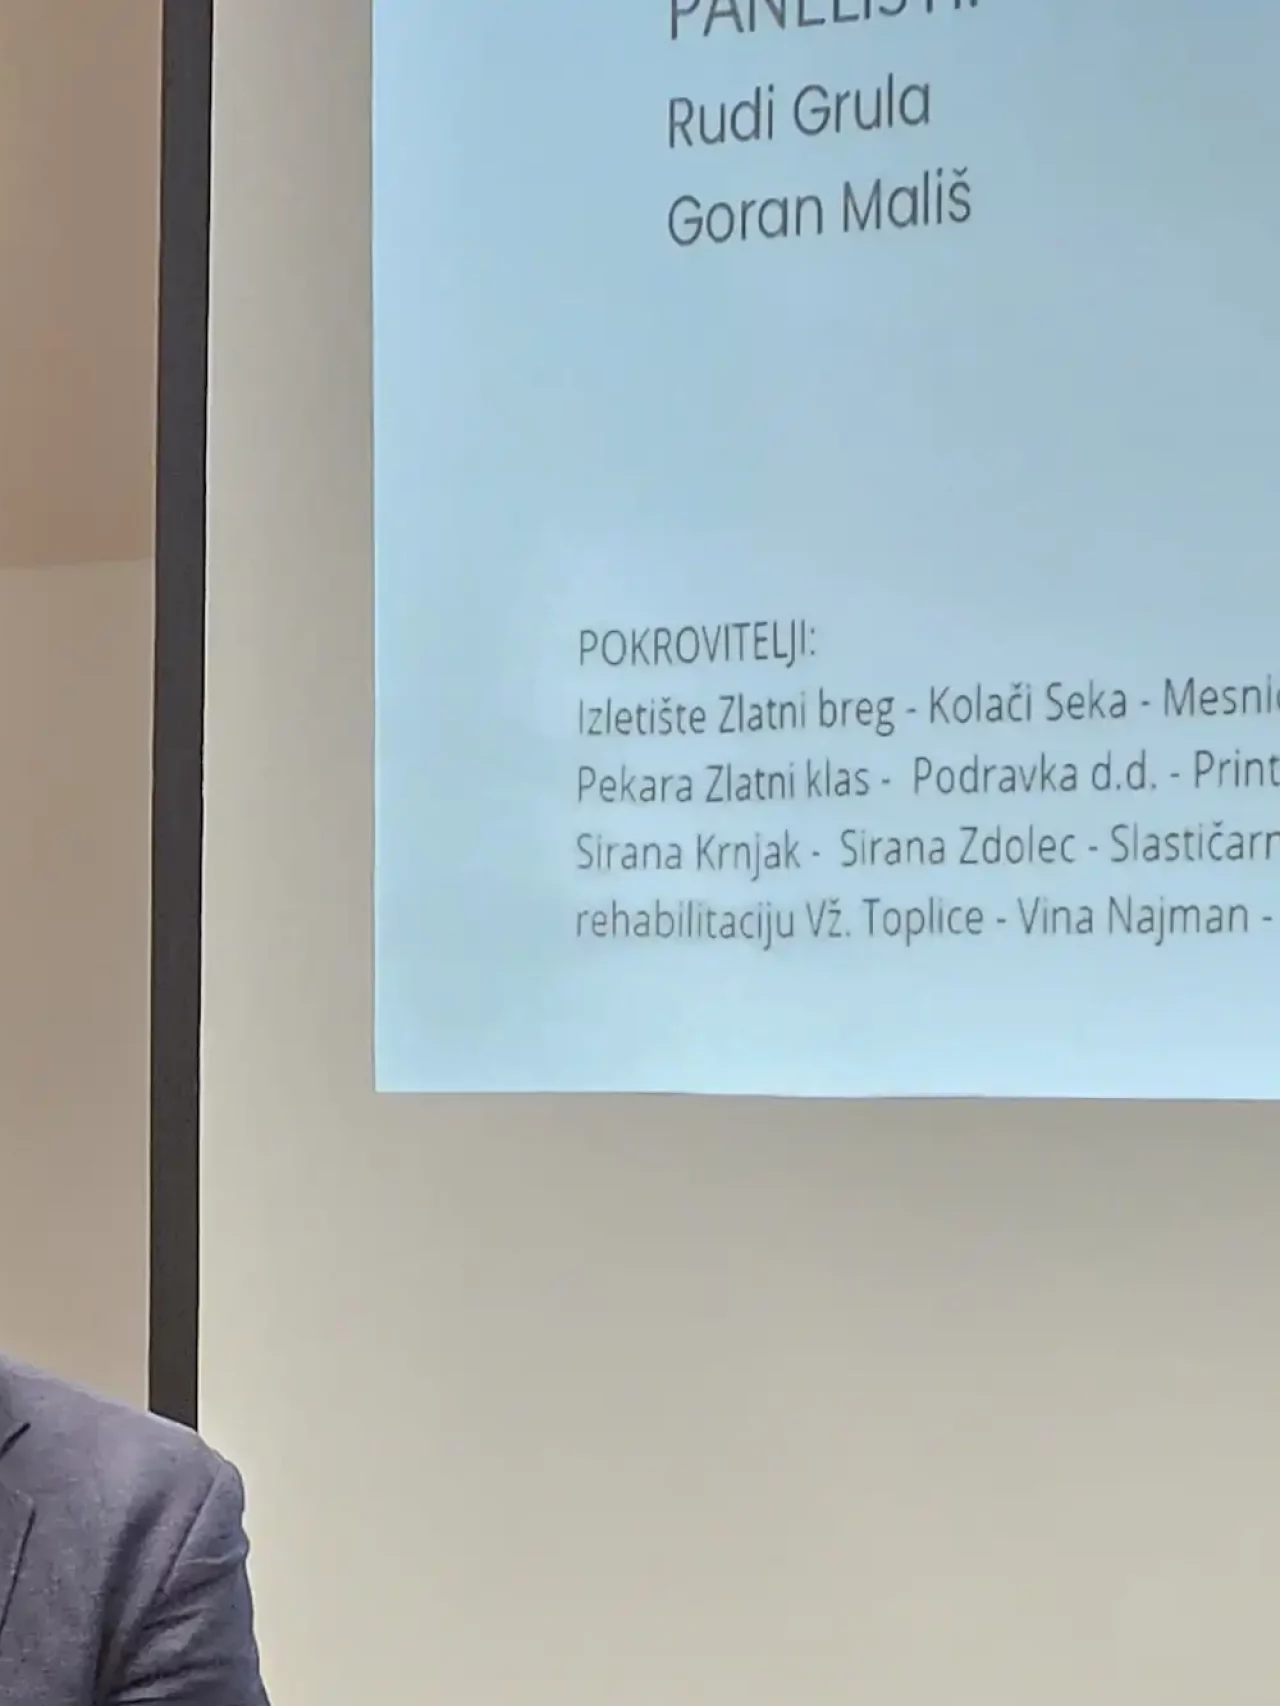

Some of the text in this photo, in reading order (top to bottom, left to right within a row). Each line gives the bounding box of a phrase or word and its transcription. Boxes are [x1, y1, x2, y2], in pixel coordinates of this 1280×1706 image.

[669, 72, 930, 149] Rudi Grula
[668, 166, 971, 247] Goran Mališ
[580, 619, 815, 669] POKROVITELJI:
[579, 697, 706, 736] Izletište
[719, 691, 805, 734] Zlatni
[819, 687, 895, 737] breg
[930, 682, 1031, 724] Kolači
[1046, 680, 1126, 721] Seka
[1164, 674, 1280, 717] Mesni
[578, 765, 692, 803] Pekara
[705, 763, 795, 803] Zlatni
[806, 758, 870, 798] klas
[914, 752, 1077, 795] Podravka
[1092, 749, 1156, 791] d.d.
[577, 833, 682, 870] Sirana
[697, 829, 800, 882] Krnjak
[841, 829, 945, 868] Sirana
[960, 824, 1075, 865] Zdolec
[577, 899, 794, 952] rehabilitaciju
[806, 898, 851, 938] Vž.
[862, 896, 983, 947] Toplice
[1017, 896, 1093, 935] Vina
[1109, 896, 1248, 947] Najman
